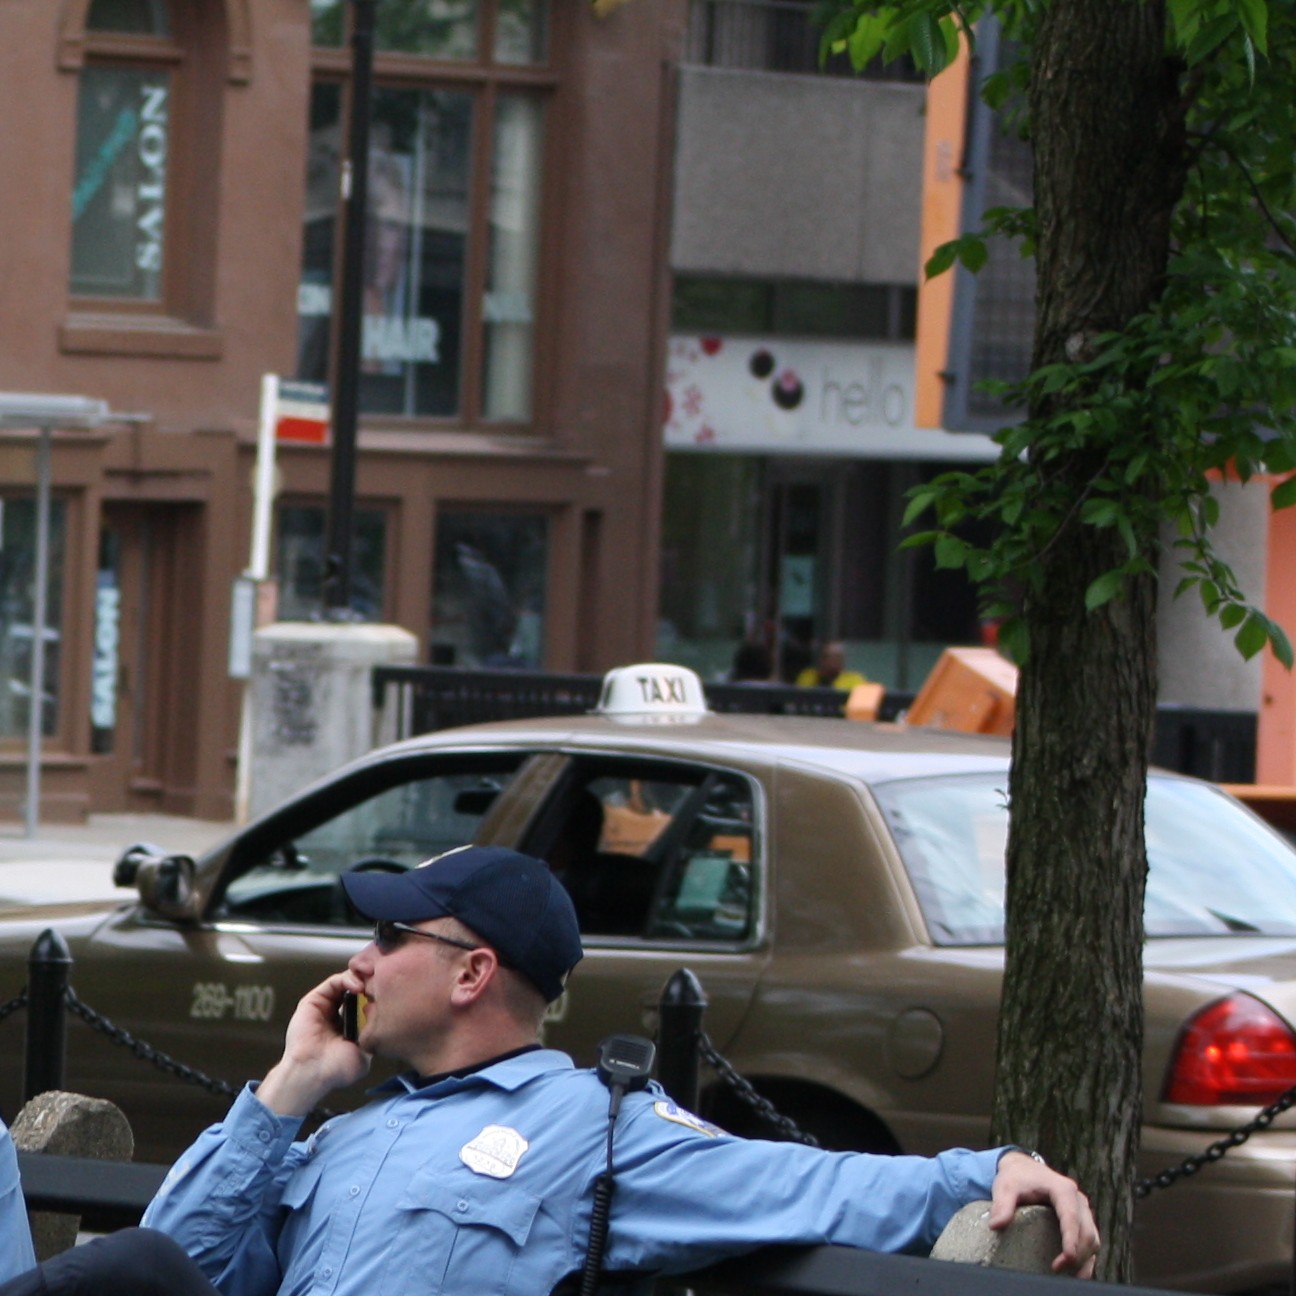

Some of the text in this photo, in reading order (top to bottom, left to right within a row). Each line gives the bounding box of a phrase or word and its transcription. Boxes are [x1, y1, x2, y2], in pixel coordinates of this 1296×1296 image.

[819, 357, 906, 426] hello
[636, 676, 687, 704] TAXI
[190, 983, 275, 1021] 269-1100
